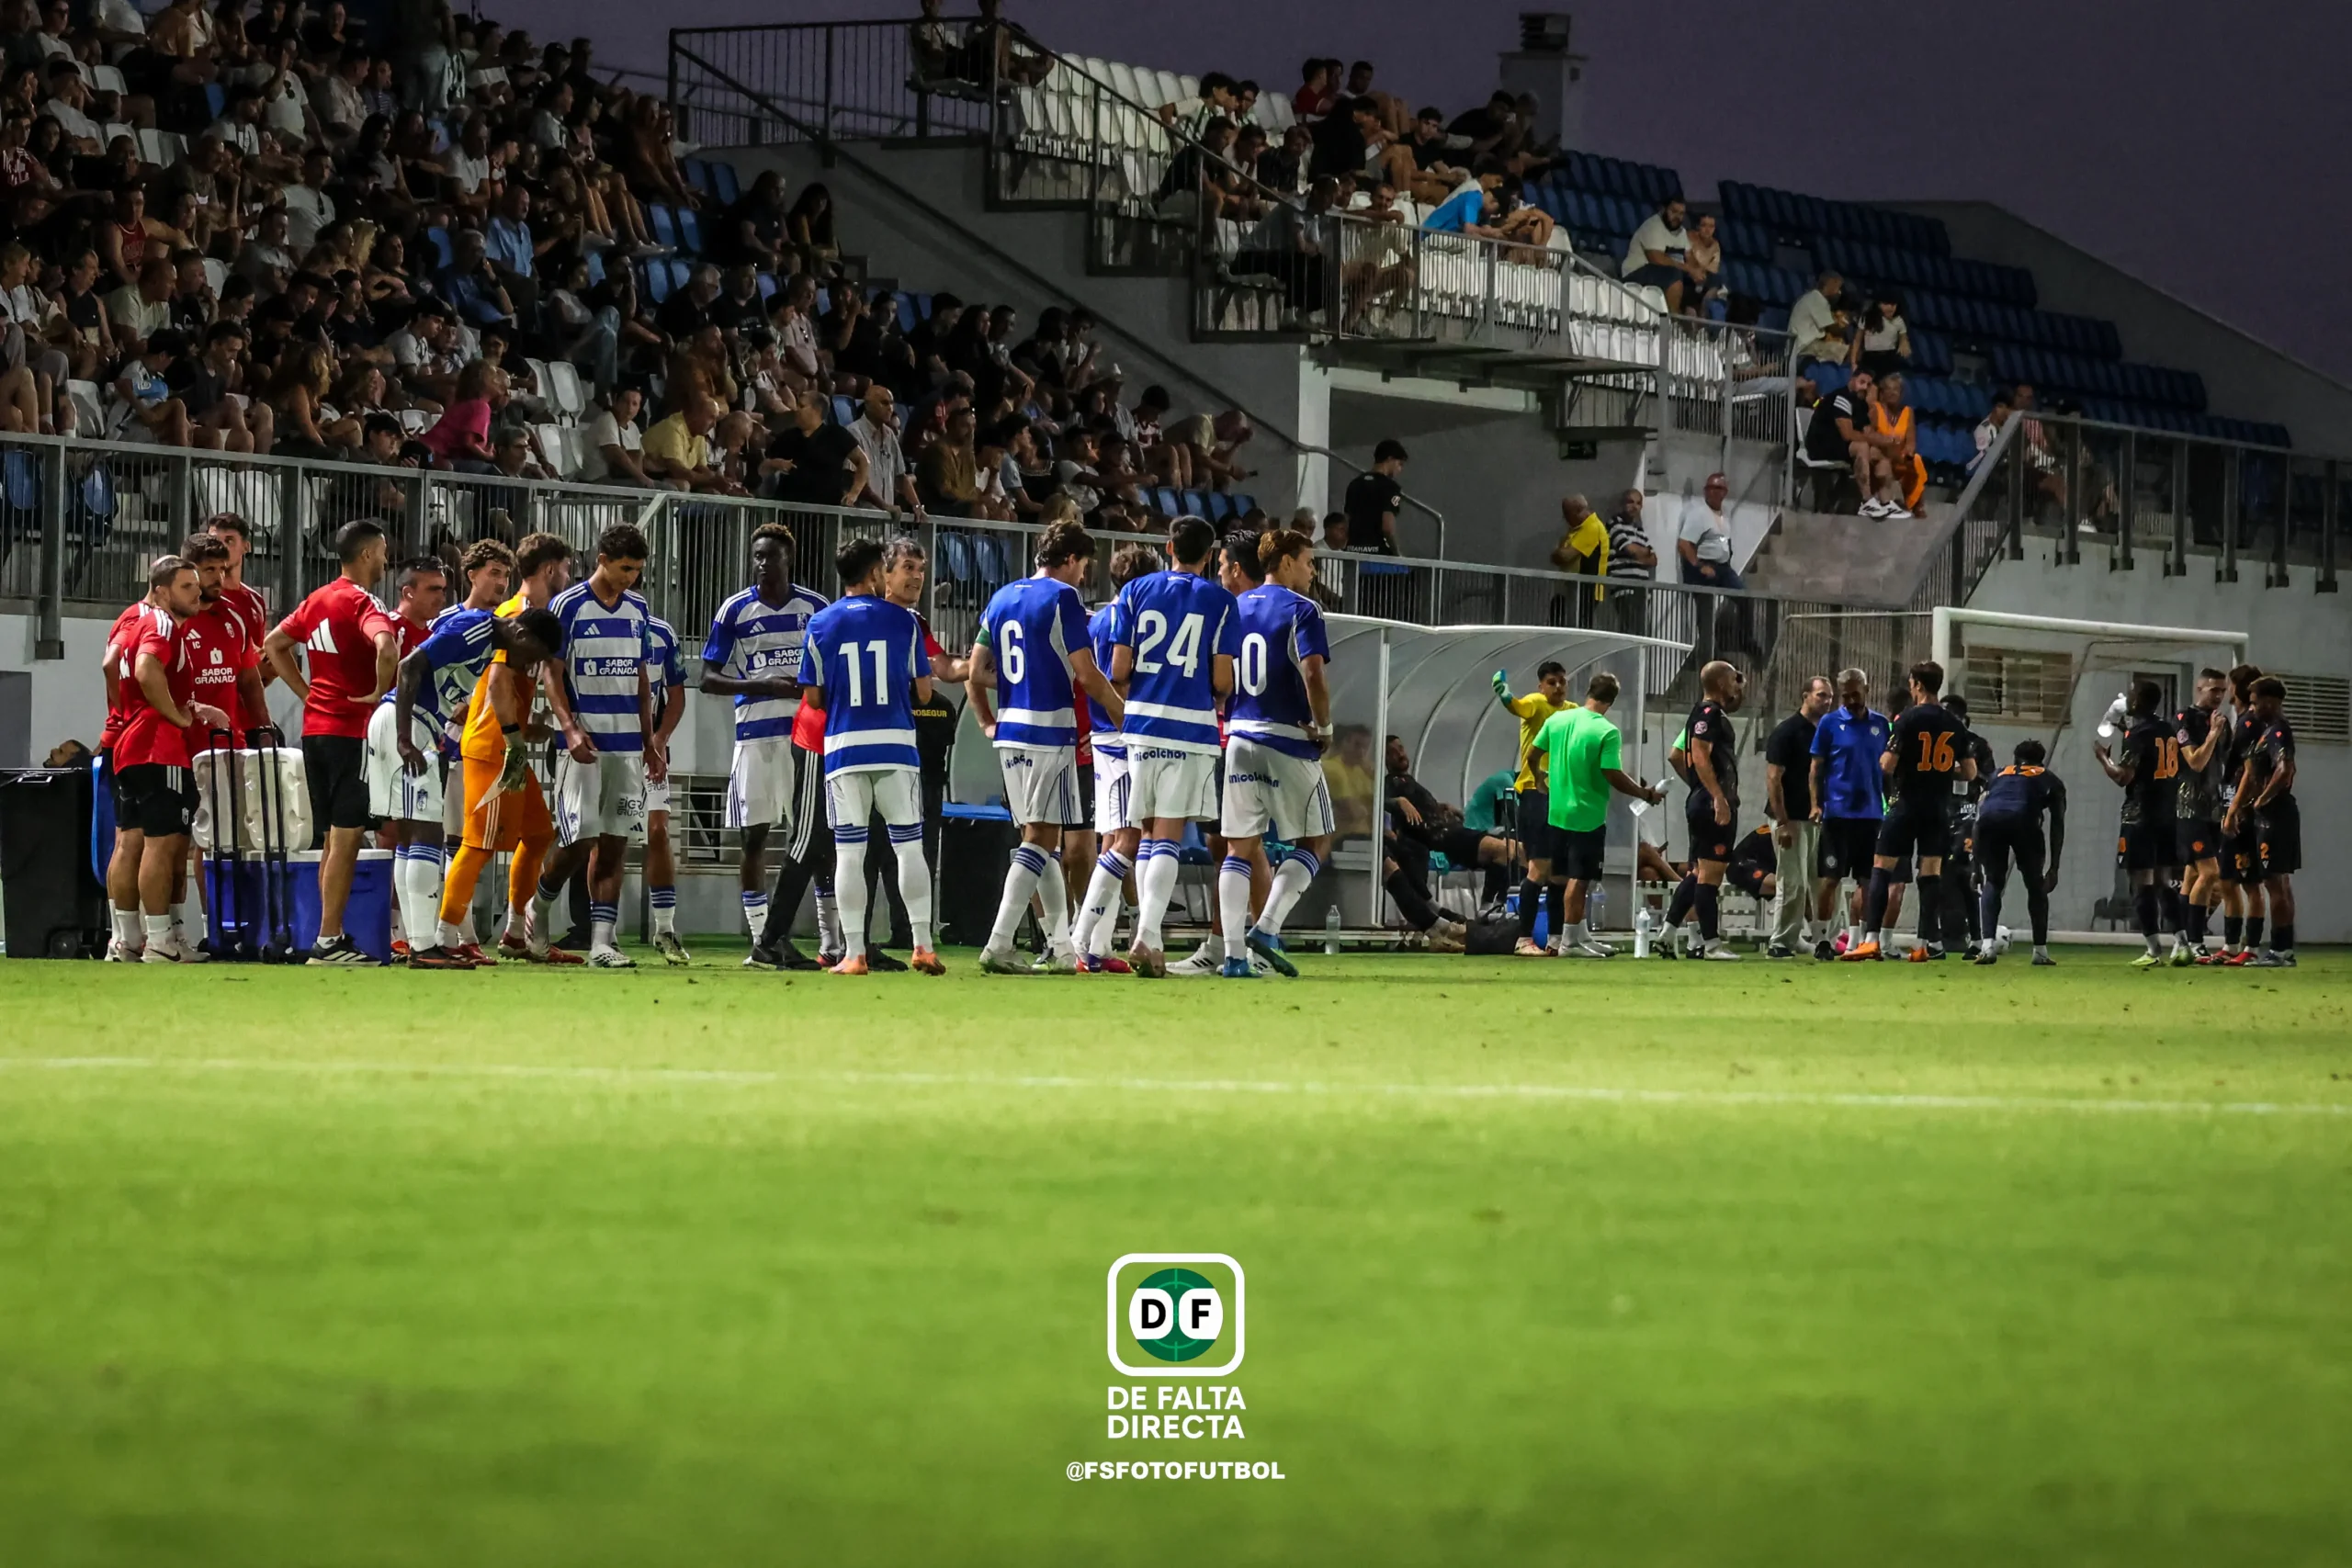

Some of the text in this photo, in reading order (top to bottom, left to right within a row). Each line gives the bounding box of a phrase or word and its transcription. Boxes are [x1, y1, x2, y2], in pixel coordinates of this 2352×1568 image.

[192, 641, 201, 649] IC
[1000, 619, 1024, 684] 6
[1136, 610, 1204, 678] 24
[201, 667, 233, 677] SABOR
[599, 667, 639, 675] GRANADA
[605, 659, 634, 667] SABOR
[838, 639, 888, 707] 11
[1917, 731, 1955, 773] 16
[2154, 736, 2179, 779] 18
[616, 808, 645, 818] GRUPO
